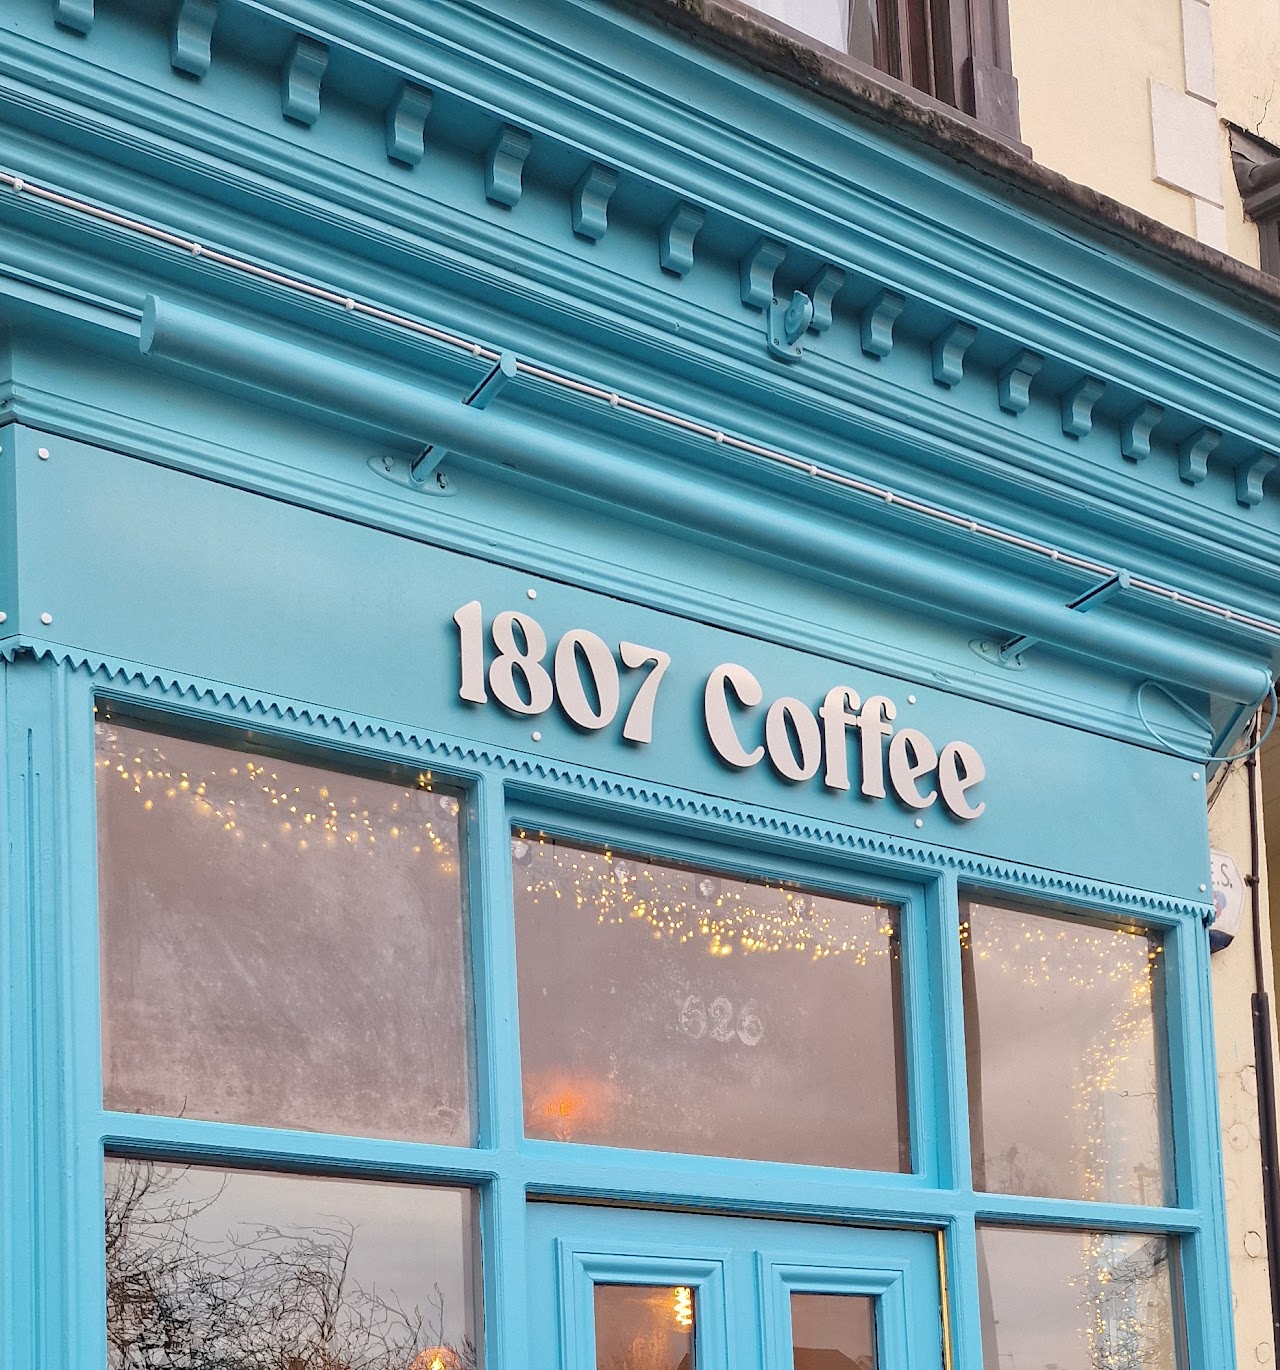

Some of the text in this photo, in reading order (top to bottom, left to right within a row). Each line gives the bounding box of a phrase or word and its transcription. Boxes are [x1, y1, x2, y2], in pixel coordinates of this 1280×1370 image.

[453, 601, 987, 819] 1807 Coffee
[681, 995, 763, 1046] 626
